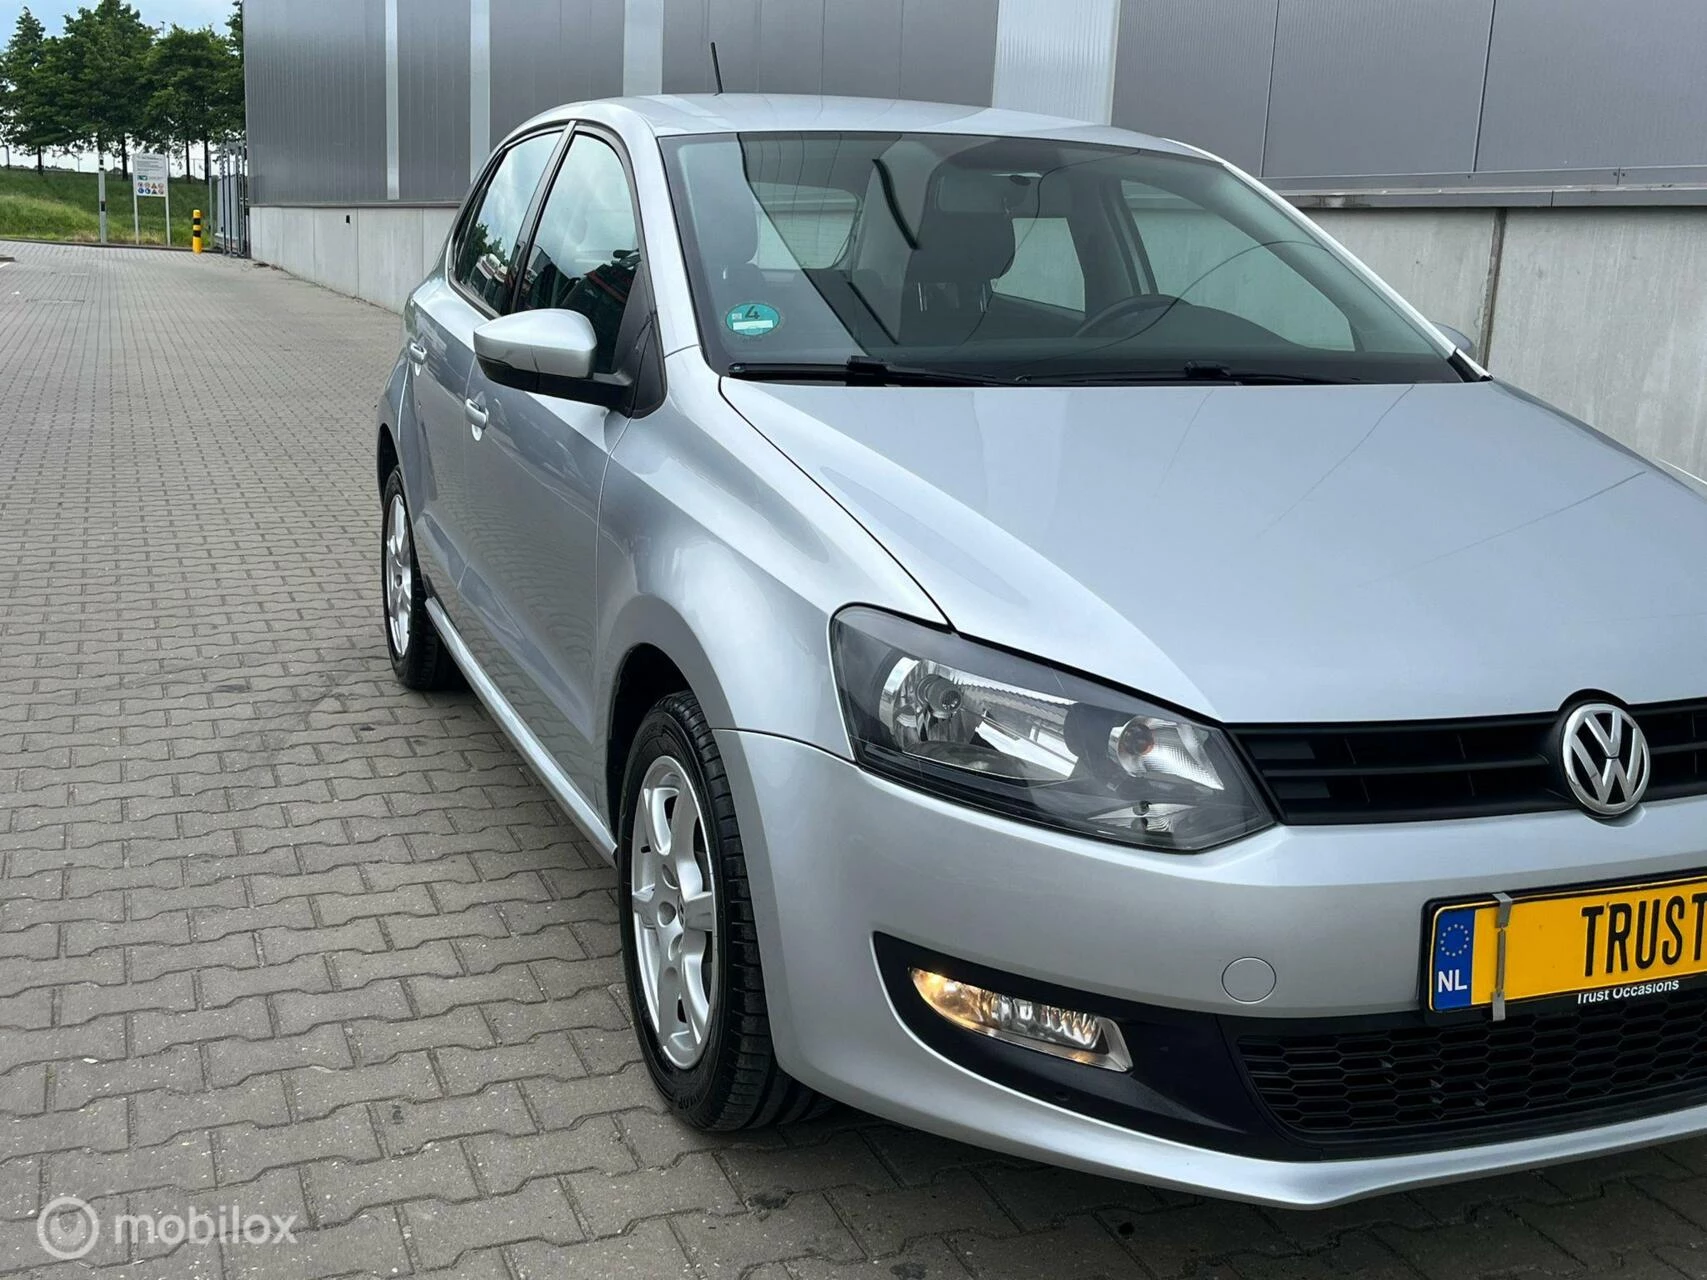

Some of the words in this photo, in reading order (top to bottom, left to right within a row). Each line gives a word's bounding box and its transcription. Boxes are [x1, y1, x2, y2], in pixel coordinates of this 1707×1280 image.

[744, 305, 760, 320] 4
[1581, 892, 1707, 977] TRUST
[1438, 968, 1468, 993] NL
[1612, 979, 1680, 999] Occasions
